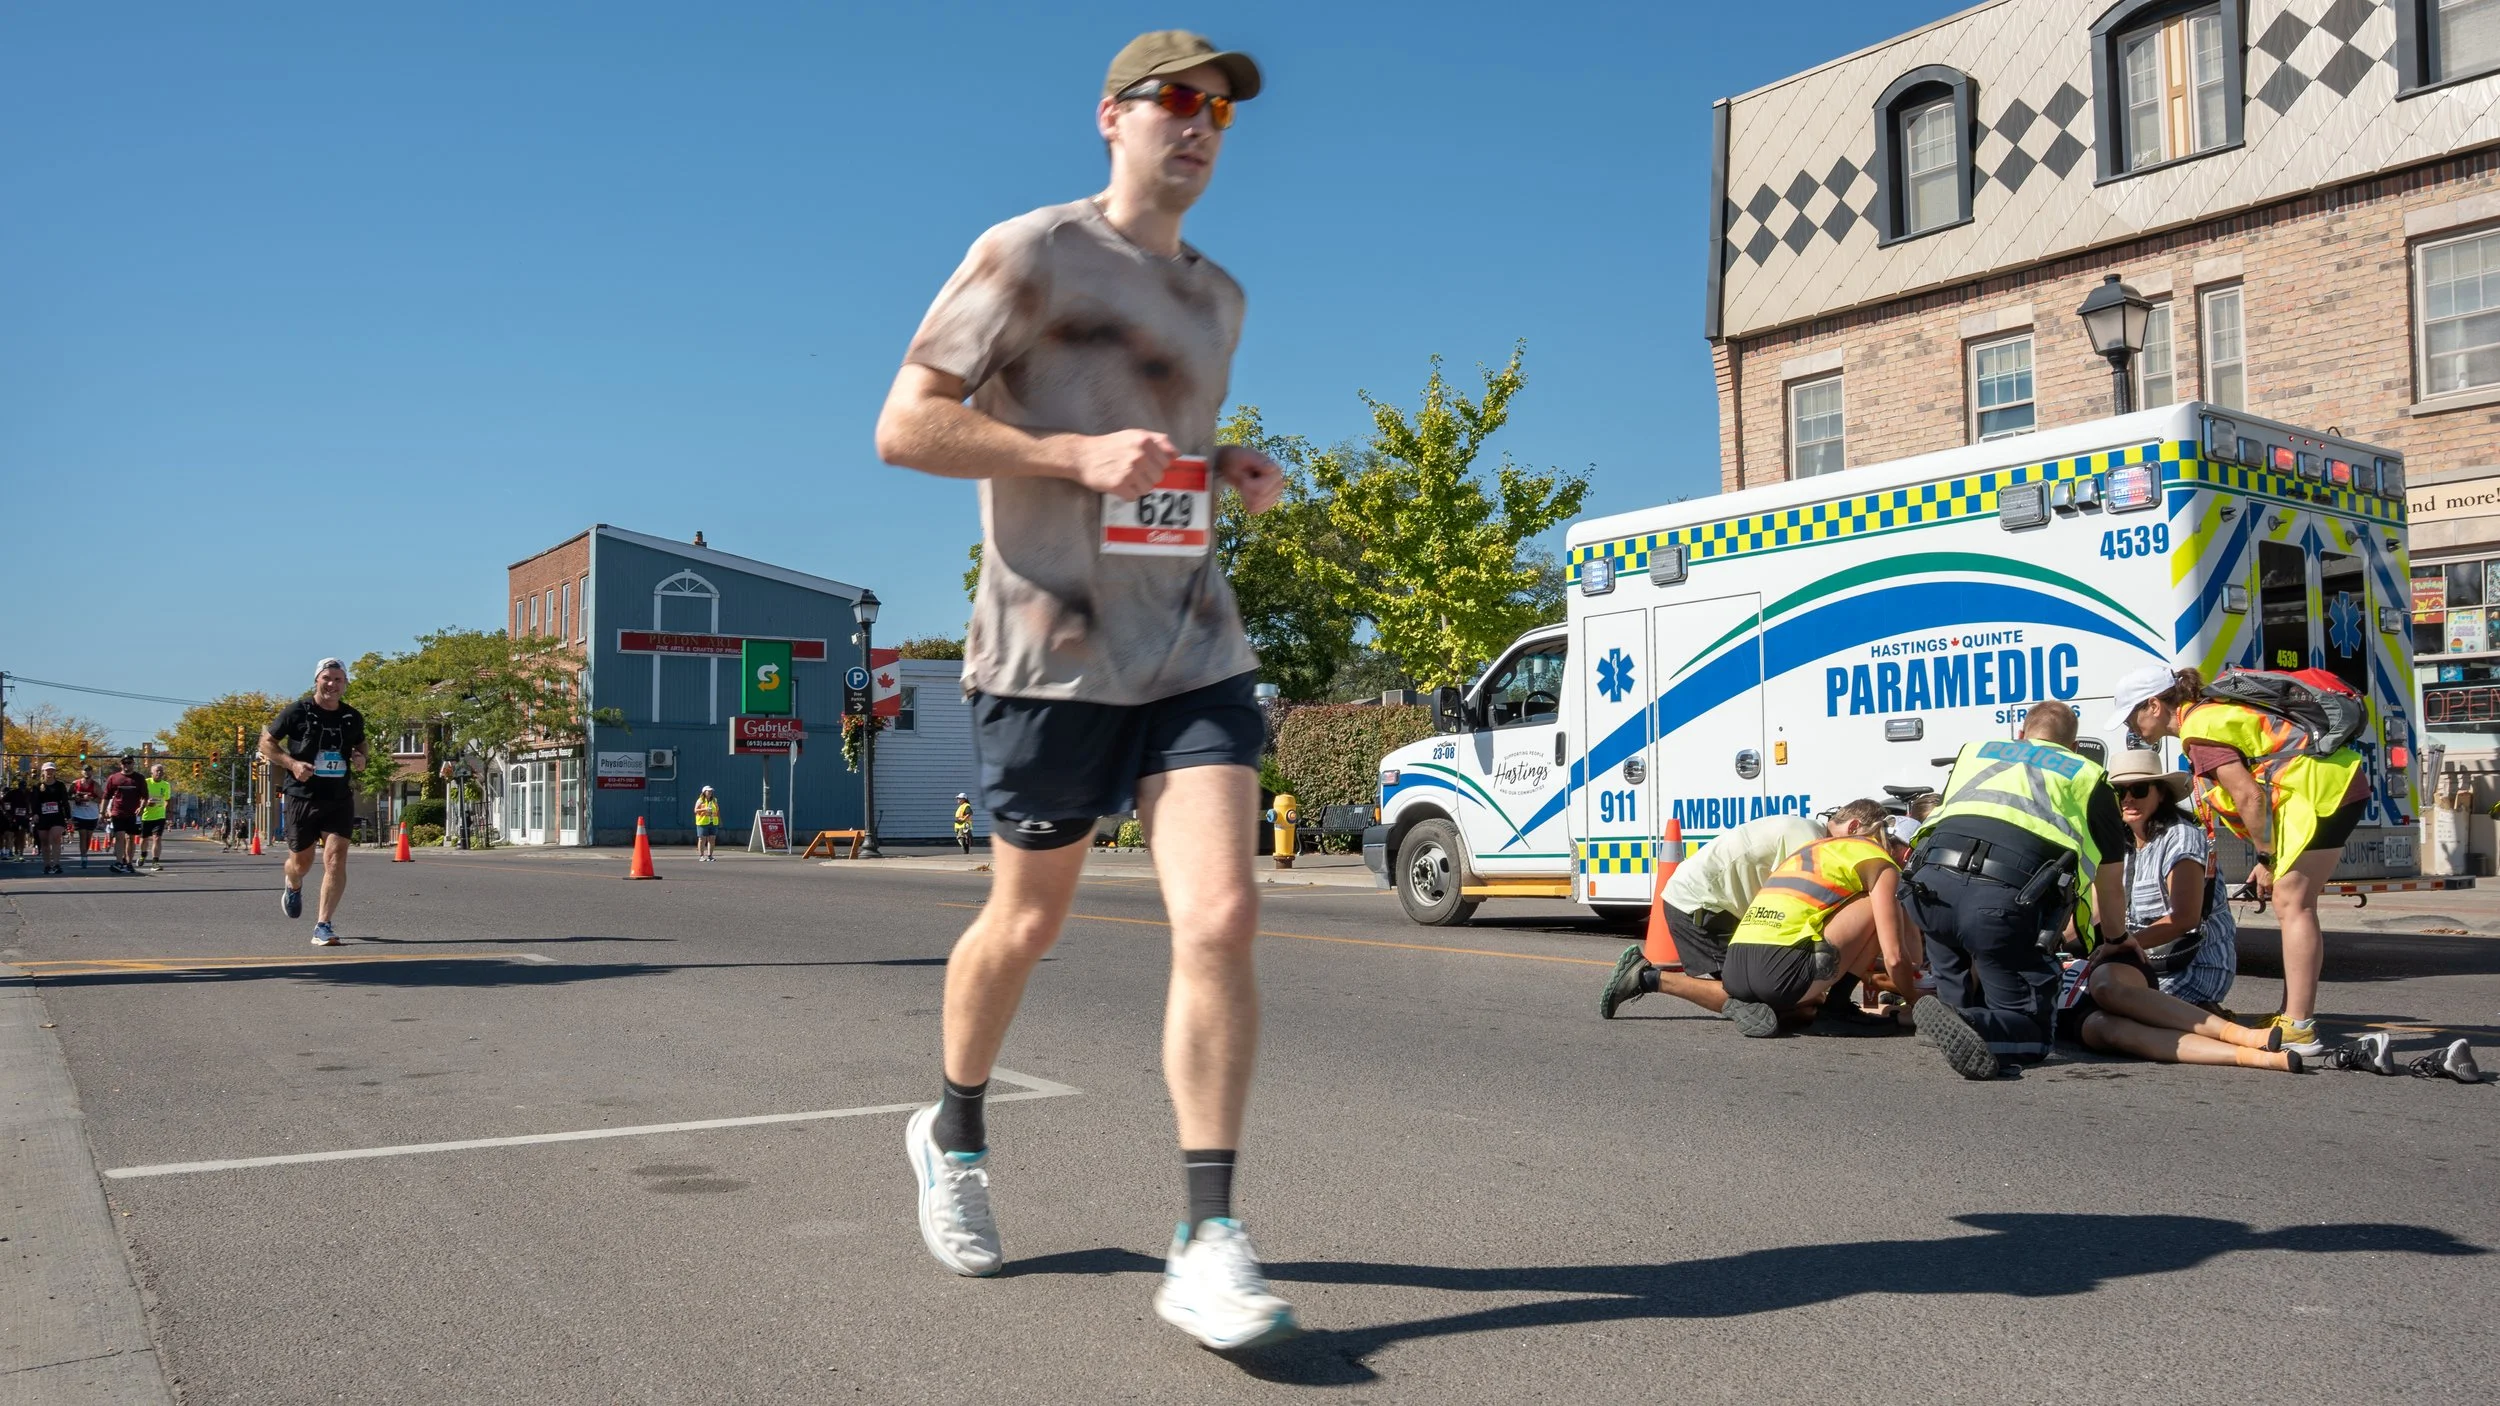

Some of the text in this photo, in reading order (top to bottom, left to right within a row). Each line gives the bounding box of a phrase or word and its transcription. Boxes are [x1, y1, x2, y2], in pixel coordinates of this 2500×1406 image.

[2447, 488, 2500, 509] more!
[1138, 492, 1193, 528] 629
[2100, 523, 2169, 561] 4539
[649, 634, 731, 647] PICTON ART
[1871, 630, 2023, 658] HASTINGS QUINTE
[2277, 650, 2298, 668] 4539
[1826, 643, 2079, 717] PARAMEDIC
[743, 720, 793, 735] Gabriel
[1433, 747, 1455, 760] 23-08
[1504, 750, 1544, 760] SUPPORTING PEOPLE
[2079, 742, 2101, 750] QUINTE
[326, 761, 339, 771] 47
[1981, 742, 2081, 777] POLICE
[1493, 760, 1549, 789] Hastings
[1517, 784, 1545, 796] COMMUNITIES
[1600, 789, 1636, 824] 911
[1672, 795, 1811, 830] AMBULANCE
[1755, 907, 1786, 921] Home
